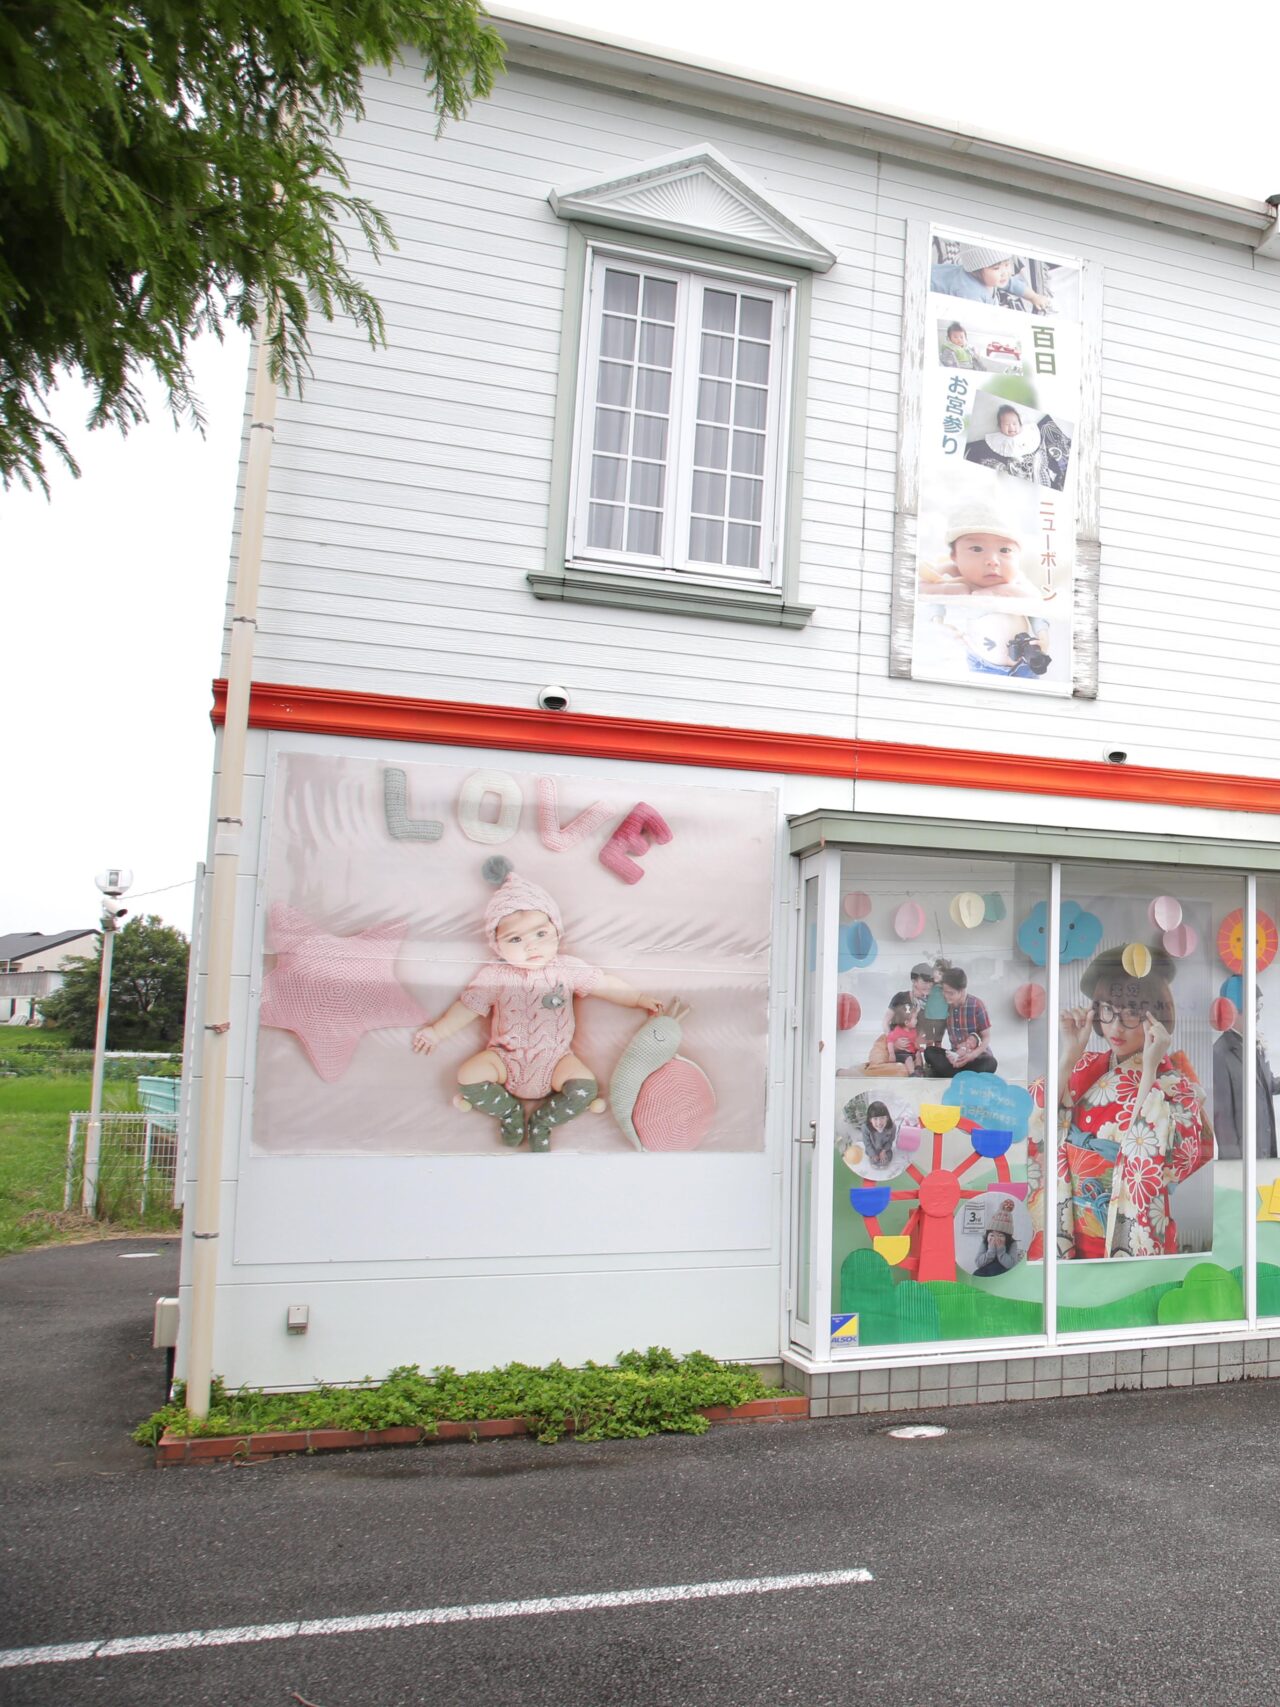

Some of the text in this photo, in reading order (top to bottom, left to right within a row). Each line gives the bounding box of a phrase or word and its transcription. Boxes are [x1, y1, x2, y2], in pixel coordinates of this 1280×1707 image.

[1031, 325, 1056, 375] 百日
[942, 375, 969, 455] お宮参り
[1039, 501, 1057, 601] ニューボーン
[383, 767, 674, 885] LOVE
